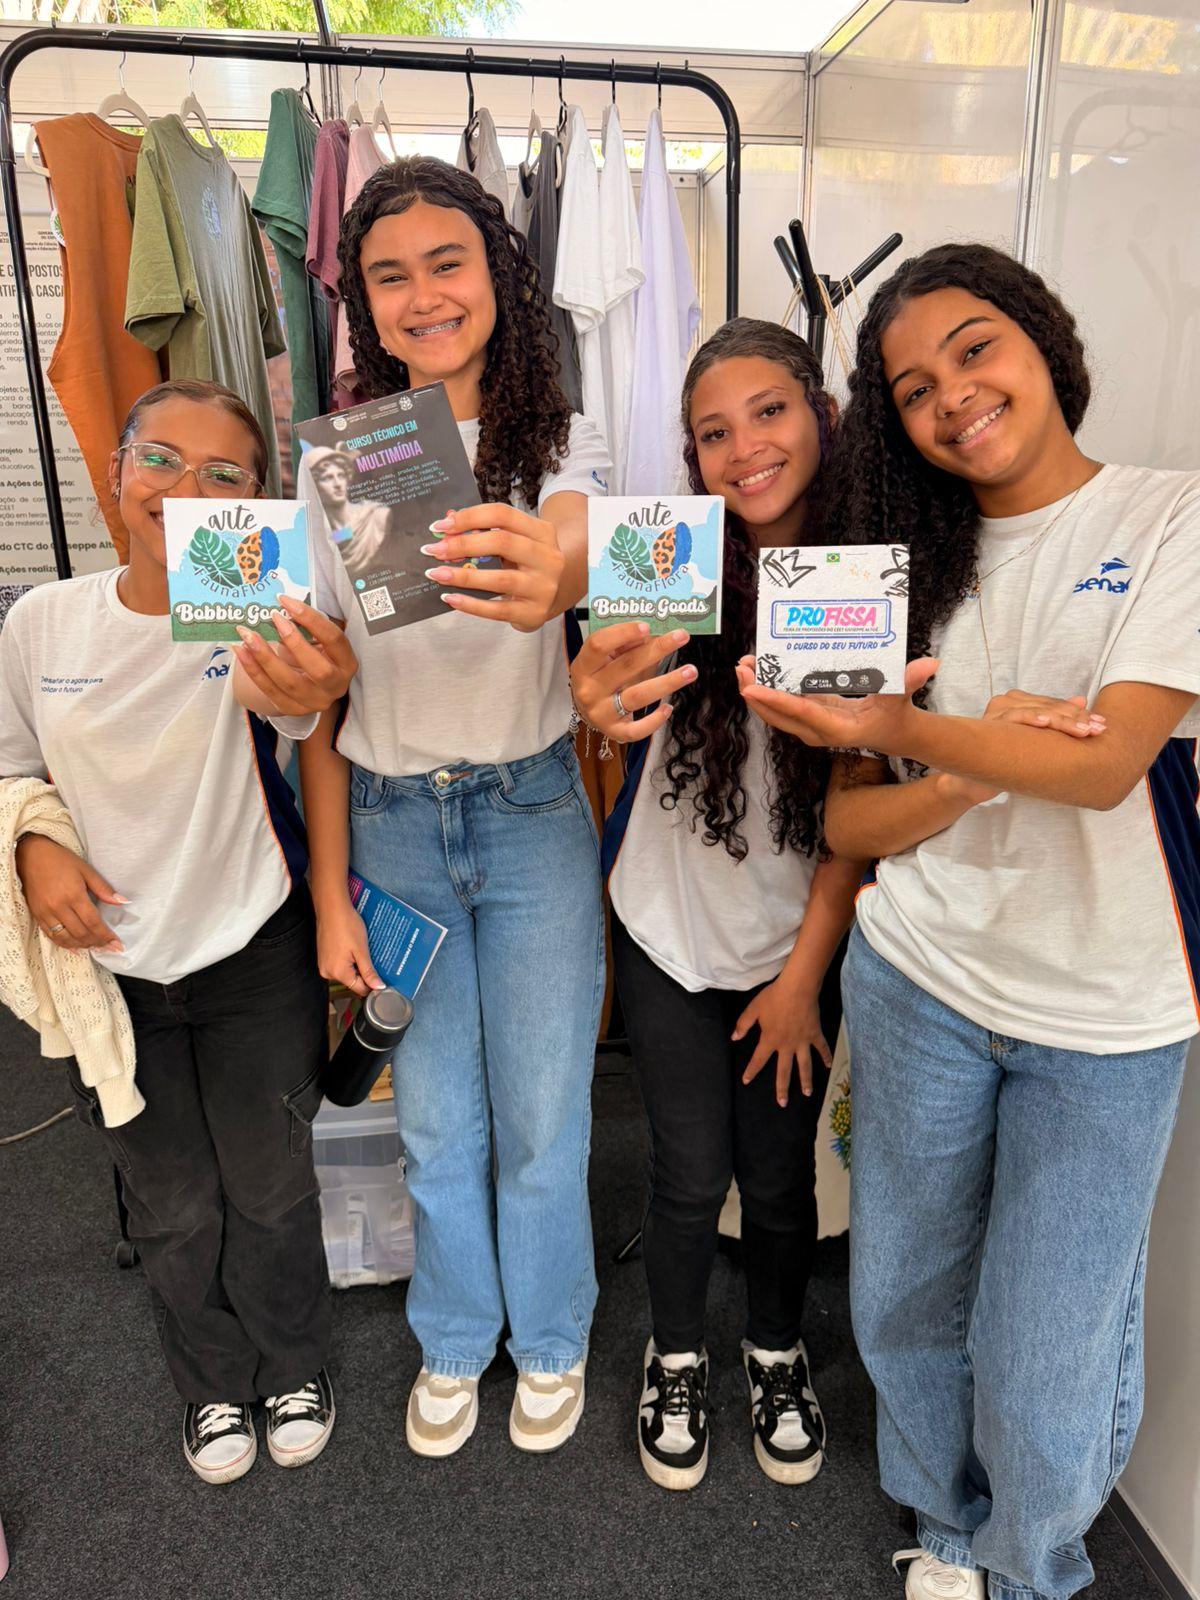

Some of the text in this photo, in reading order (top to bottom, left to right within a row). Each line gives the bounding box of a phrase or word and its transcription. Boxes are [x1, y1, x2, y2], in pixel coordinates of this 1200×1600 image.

[346, 419, 418, 451] CURSO TÉCNICO EM
[355, 440, 423, 473] MULTIMÍDIA
[7, 480, 31, 488] Ações
[208, 505, 257, 531] arte
[629, 502, 674, 527] arte
[14, 543, 34, 551] CTC
[176, 604, 245, 623] Bobbie
[594, 599, 708, 618] Bobbie Goods
[787, 607, 877, 627] PROFISSA
[793, 642, 818, 650] CURSO
[820, 642, 830, 650] DO
[831, 642, 846, 650] SEU
[848, 641, 878, 649] FUTURO
